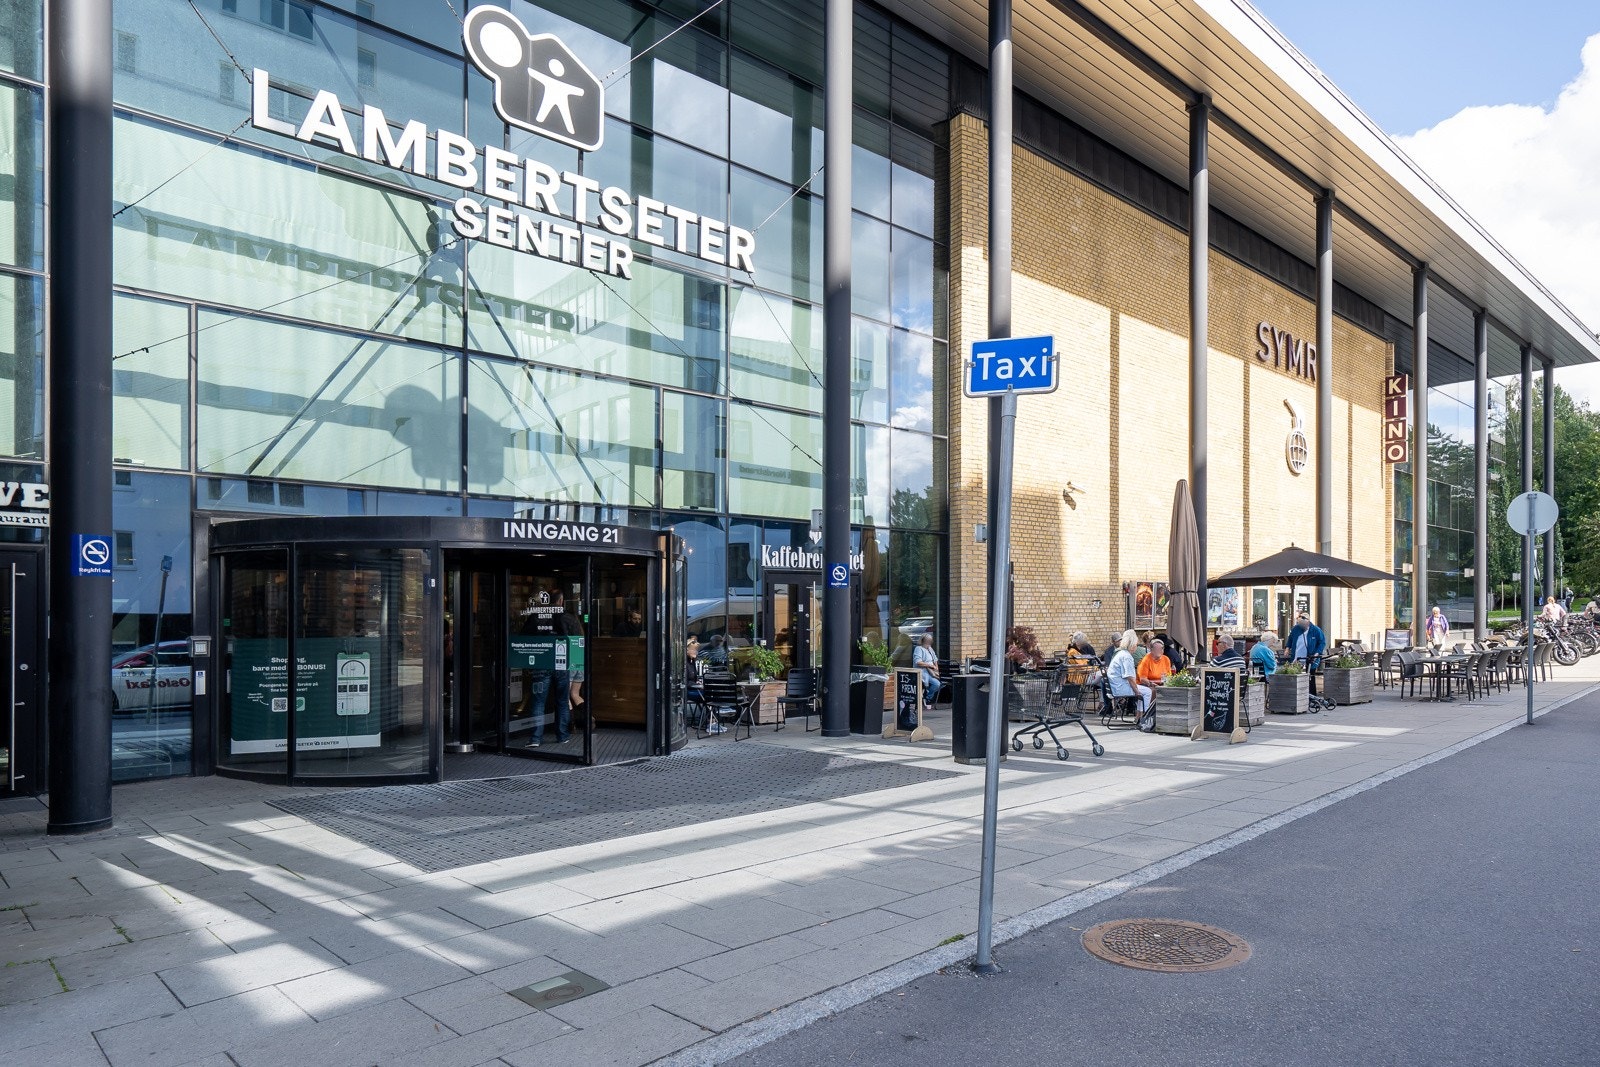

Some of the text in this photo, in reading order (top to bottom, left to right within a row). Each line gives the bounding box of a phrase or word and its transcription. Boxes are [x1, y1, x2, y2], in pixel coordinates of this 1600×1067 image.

[252, 68, 755, 273] LAMBERTSETER
[452, 198, 633, 280] SENTER
[976, 347, 1048, 381] Taxi
[1387, 377, 1405, 461] KINO
[503, 522, 618, 543] INNGANG 21
